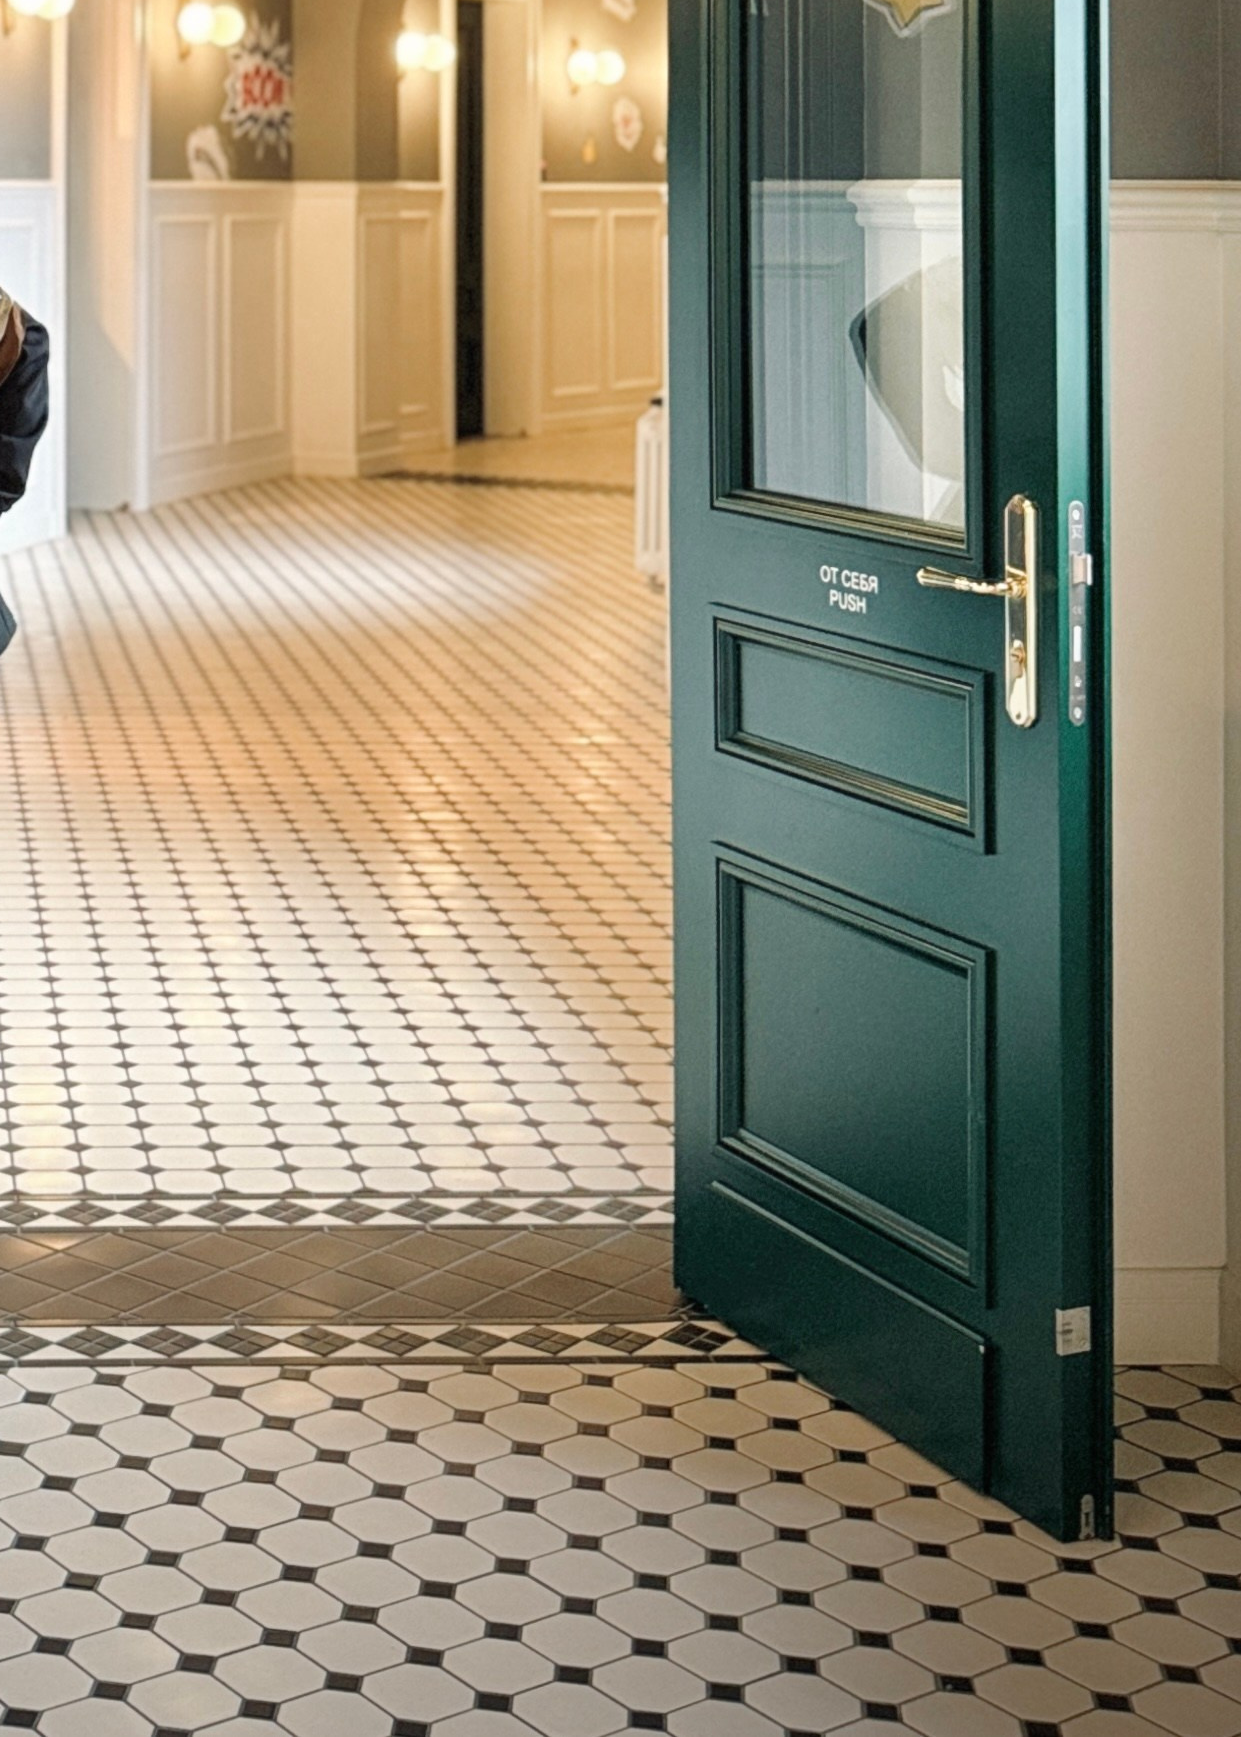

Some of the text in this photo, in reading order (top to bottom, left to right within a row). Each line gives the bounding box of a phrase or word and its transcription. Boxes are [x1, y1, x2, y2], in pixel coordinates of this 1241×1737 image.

[819, 565, 879, 594] ОТ СЕБЯ
[829, 589, 867, 614] PUSH
